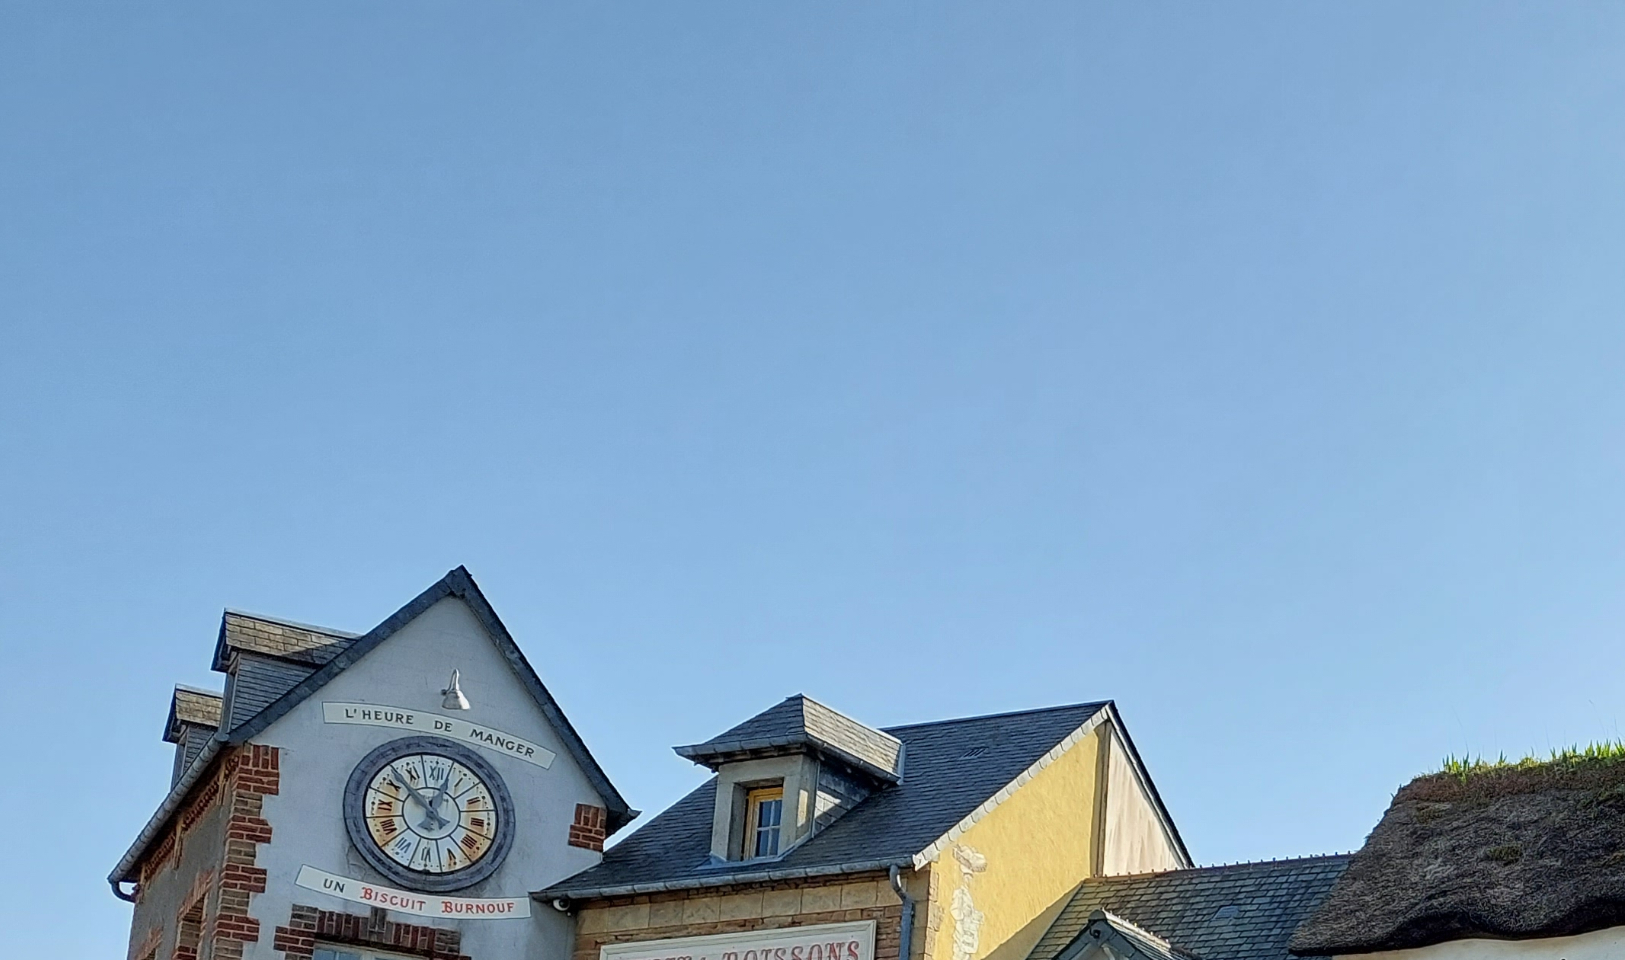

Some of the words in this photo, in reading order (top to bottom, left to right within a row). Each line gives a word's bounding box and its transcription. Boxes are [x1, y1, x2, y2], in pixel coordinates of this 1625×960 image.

[345, 708, 414, 725] L'HEURE
[434, 721, 453, 732] DE
[470, 729, 535, 758] MANGER
[323, 879, 345, 893] UN
[360, 887, 426, 911] BISCUIT
[441, 901, 515, 914] BURNOUF
